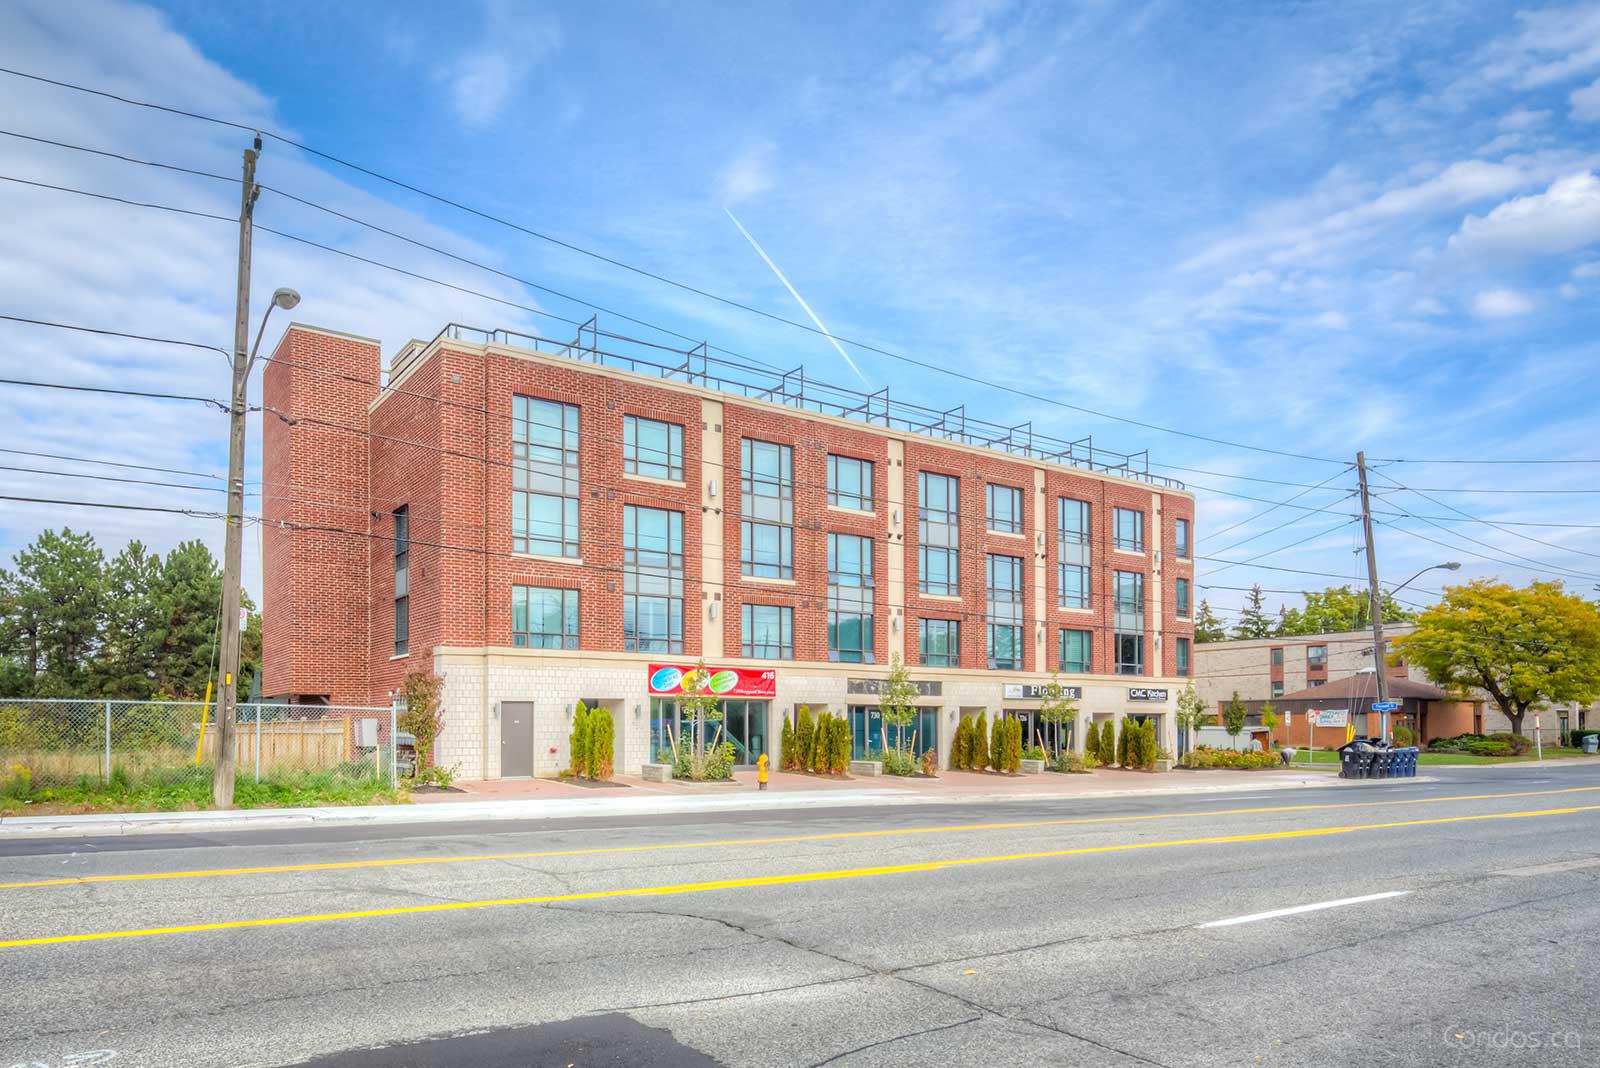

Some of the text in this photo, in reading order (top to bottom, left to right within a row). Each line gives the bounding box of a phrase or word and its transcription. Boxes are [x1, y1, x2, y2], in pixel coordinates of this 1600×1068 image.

[761, 671, 775, 680] 416
[1031, 684, 1076, 699] Floong
[870, 711, 881, 720] 730
